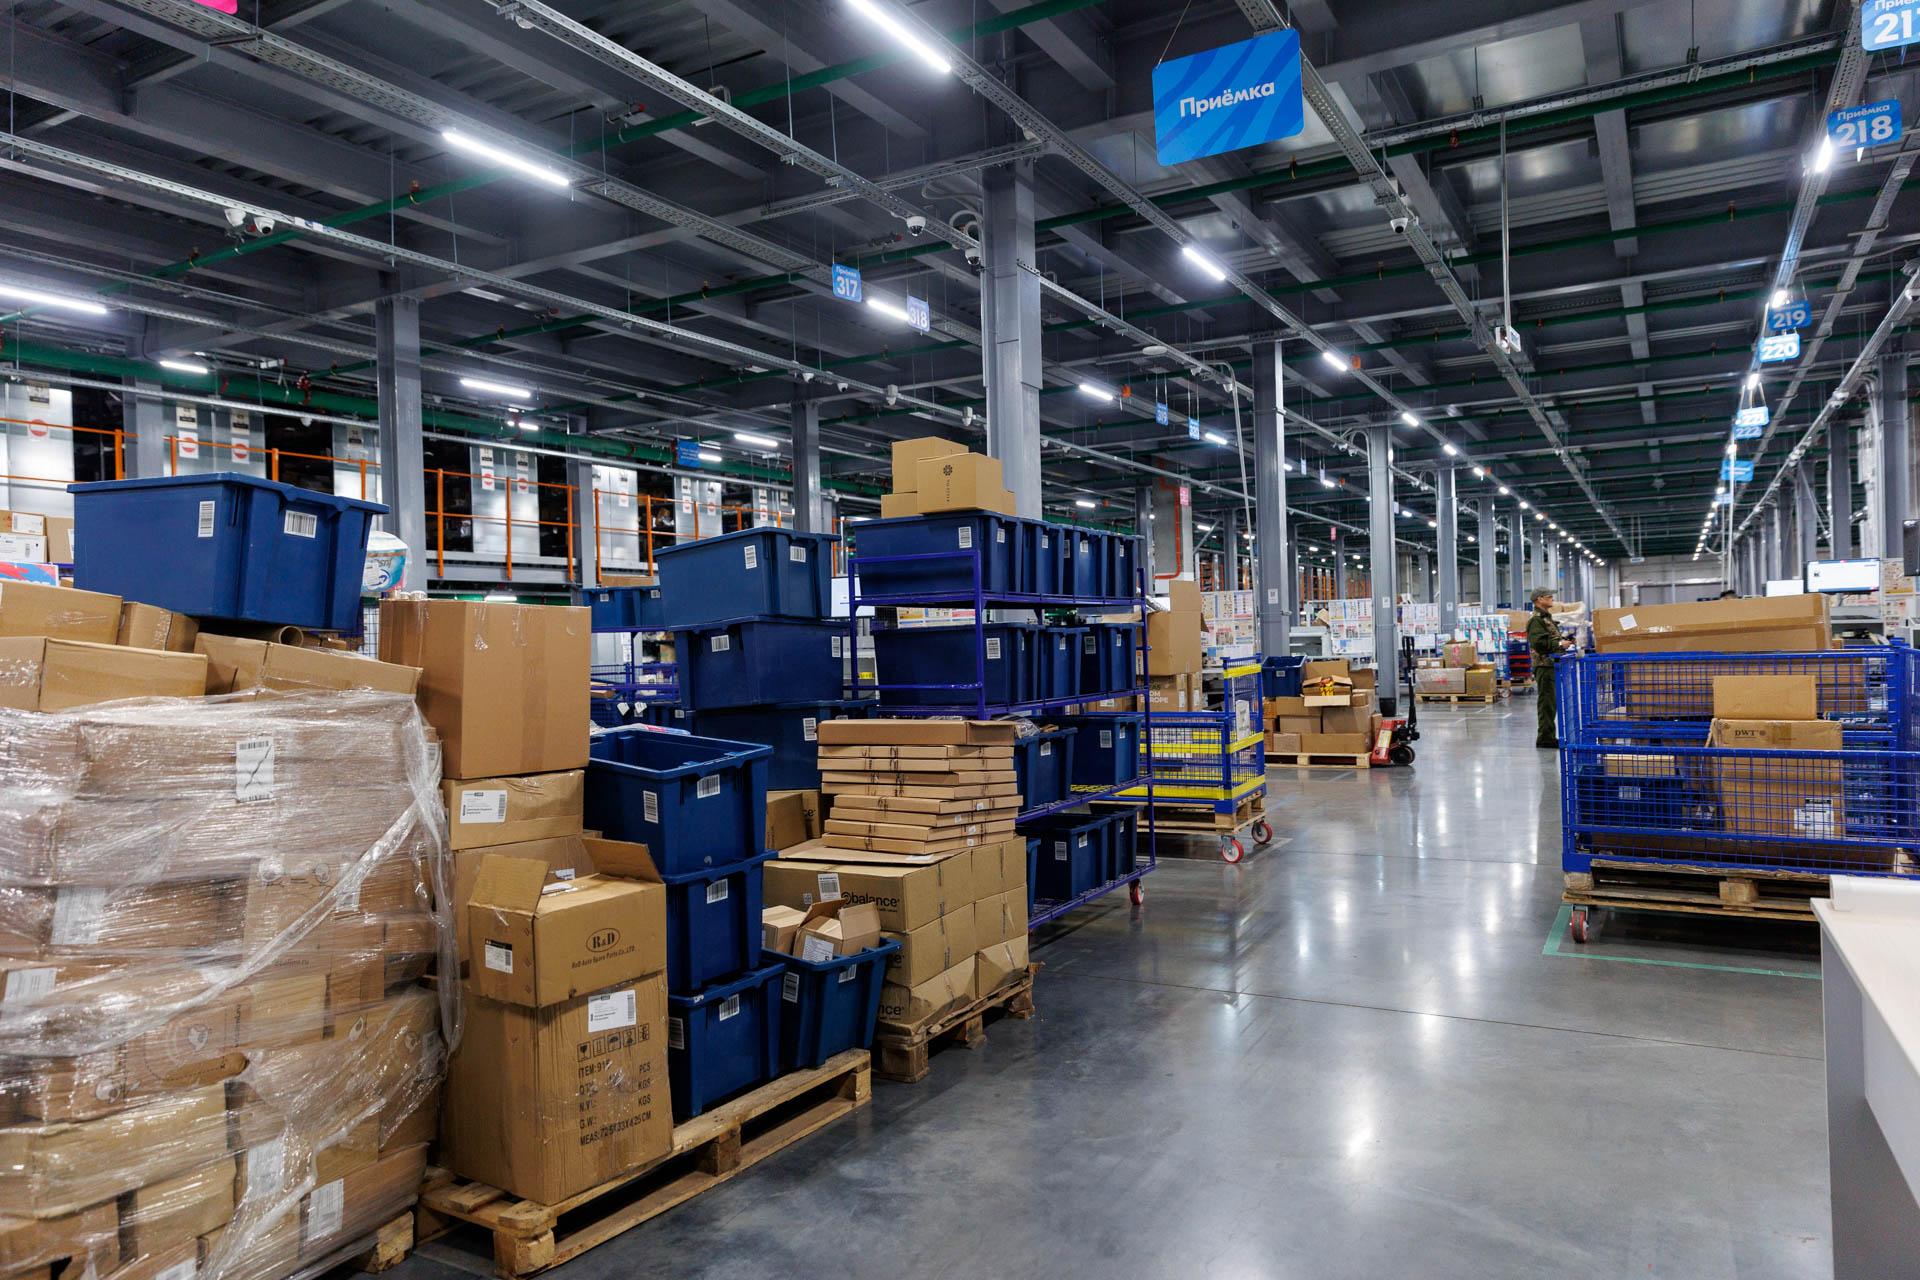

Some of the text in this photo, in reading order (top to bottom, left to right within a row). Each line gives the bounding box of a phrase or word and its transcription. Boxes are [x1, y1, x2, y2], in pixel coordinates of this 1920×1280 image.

[1180, 82, 1275, 118] Приёмка
[1837, 104, 1890, 121] Приёмка
[1836, 115, 1893, 147] 218
[837, 275, 858, 298] 317
[910, 306, 928, 328] 318
[1773, 309, 1807, 328] 219
[1761, 342, 1798, 360] 220
[1734, 729, 1756, 737] DWT
[592, 932, 615, 949] R&D
[639, 1062, 651, 1074] PCS
[638, 1078, 651, 1090] KGS
[638, 1094, 652, 1107] KGS
